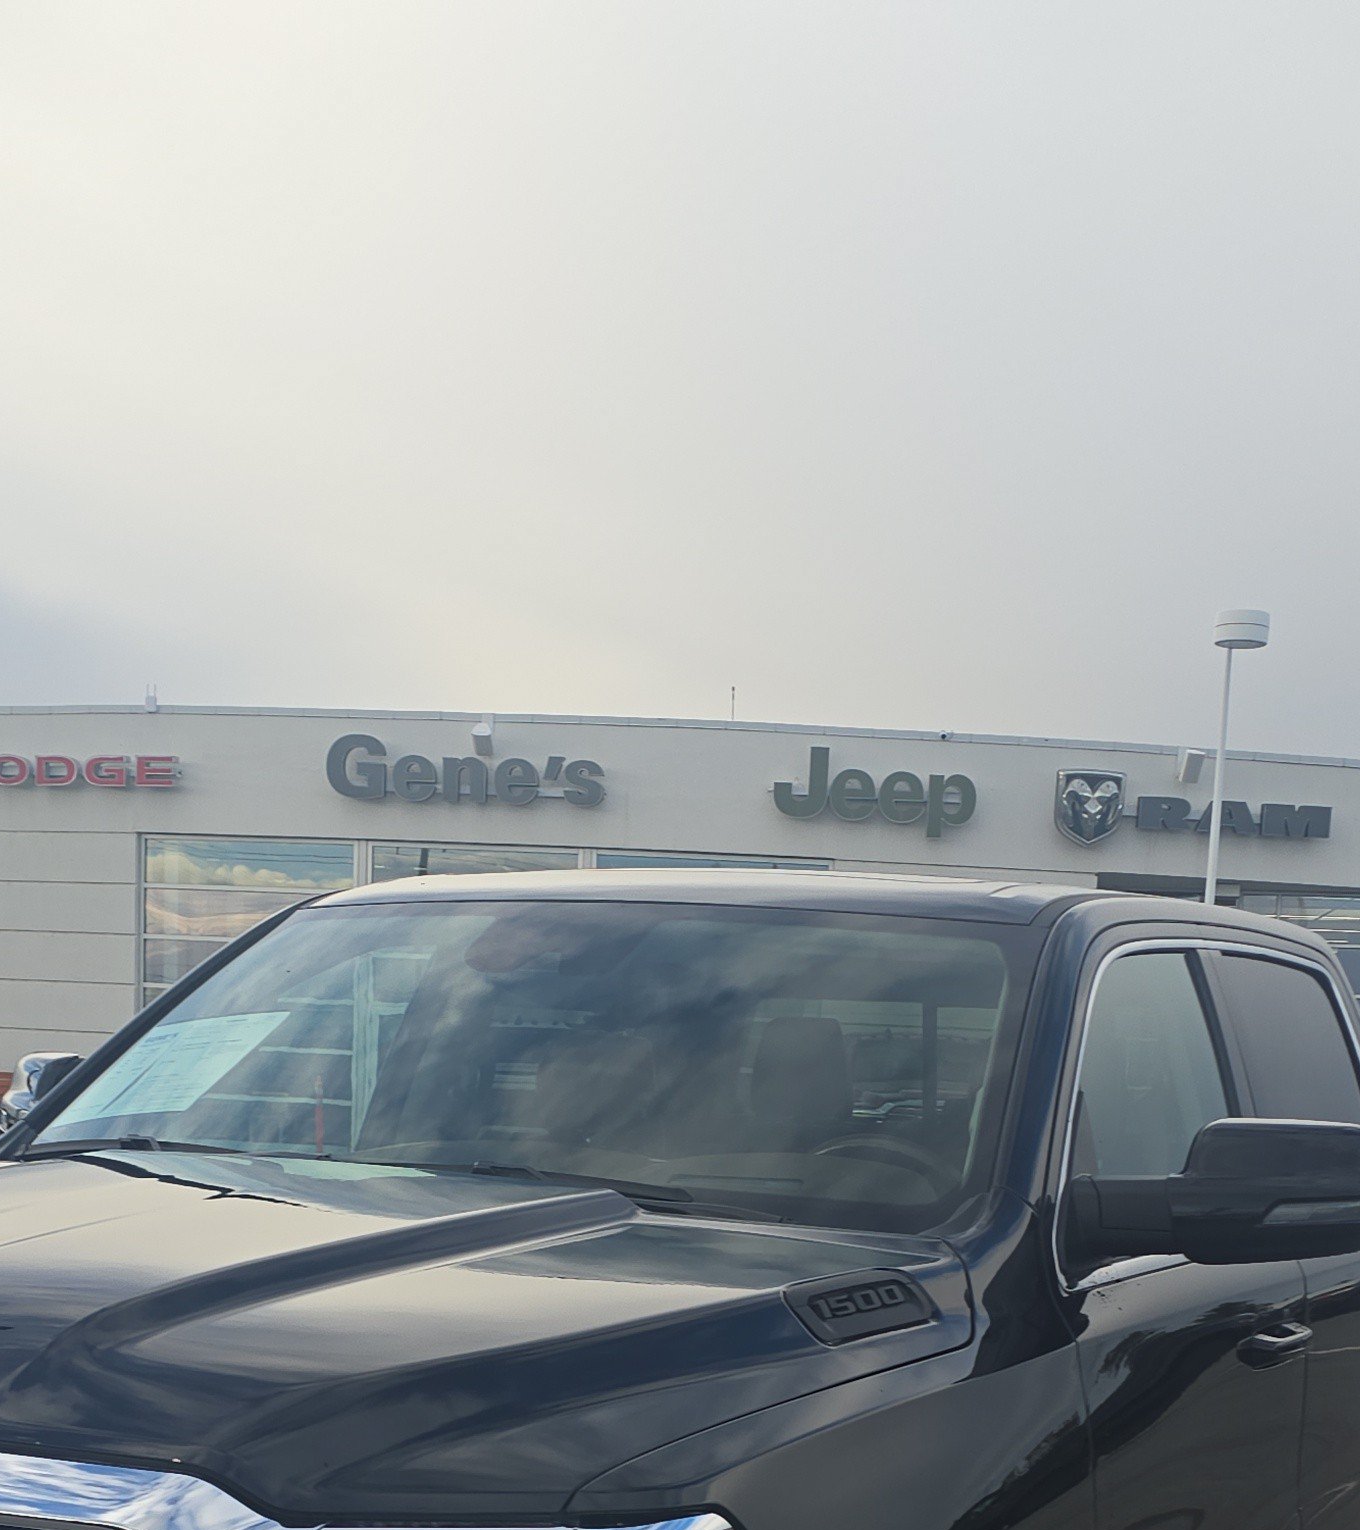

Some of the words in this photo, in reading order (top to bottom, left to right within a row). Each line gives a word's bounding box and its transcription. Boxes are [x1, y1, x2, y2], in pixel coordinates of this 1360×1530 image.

[326, 734, 606, 807] Gene's
[773, 746, 977, 838] Jeep
[1136, 796, 1333, 838] RAM
[815, 1284, 906, 1319] 1500
